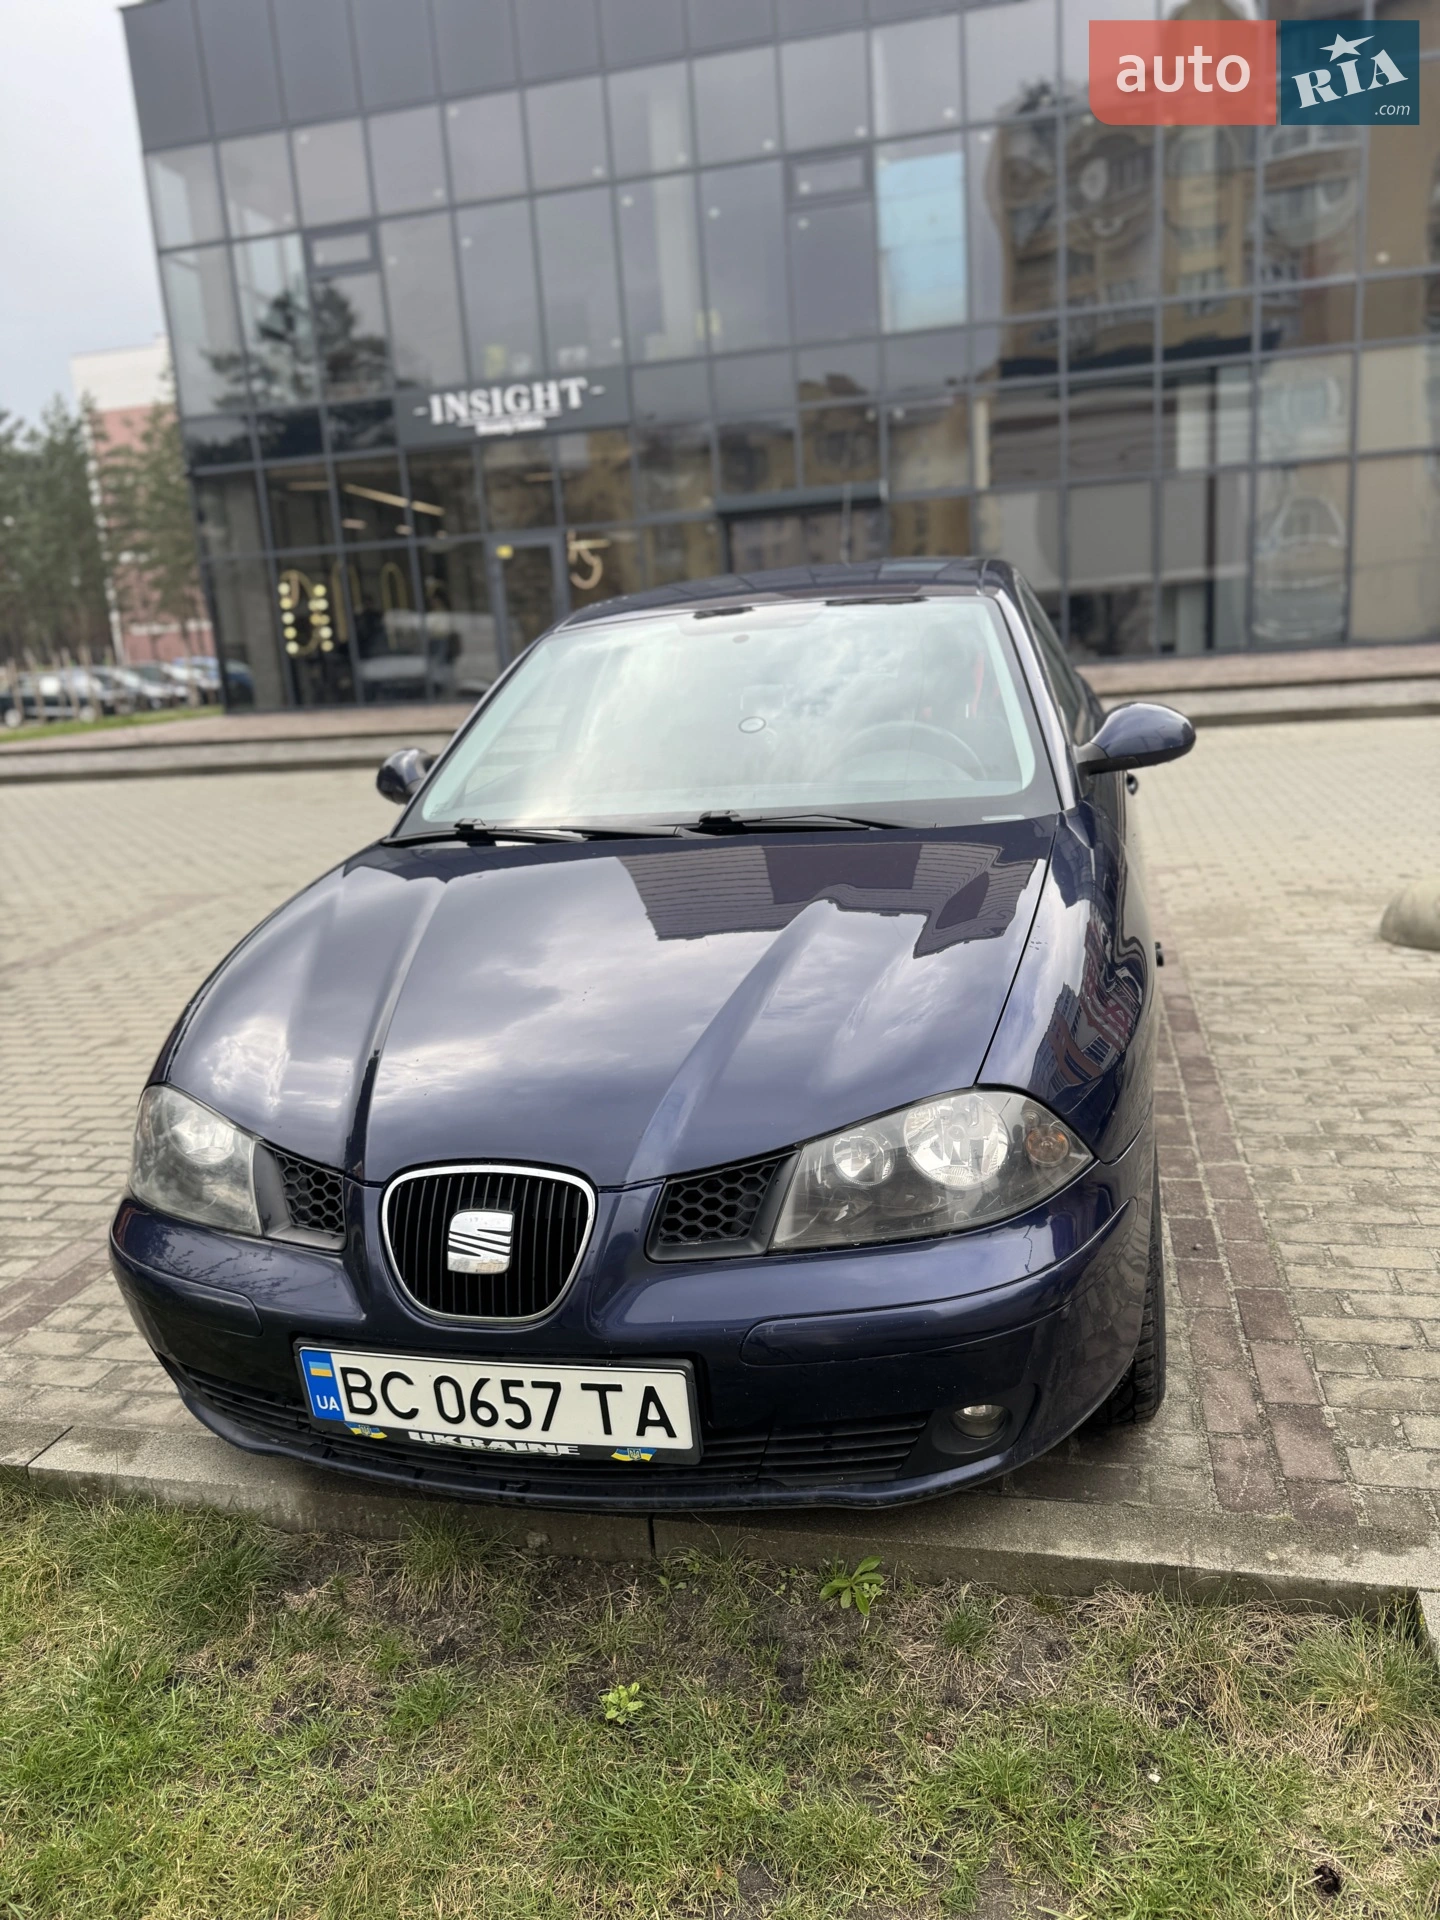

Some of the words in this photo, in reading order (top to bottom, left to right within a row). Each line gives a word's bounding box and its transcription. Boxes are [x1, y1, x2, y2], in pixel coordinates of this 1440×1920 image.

[428, 376, 588, 426] INSIGHT
[316, 1394, 341, 1412] UA
[339, 1366, 420, 1420] BC
[432, 1375, 563, 1432] 0657
[580, 1382, 678, 1438] TA
[408, 1431, 581, 1456] UKRAINE
